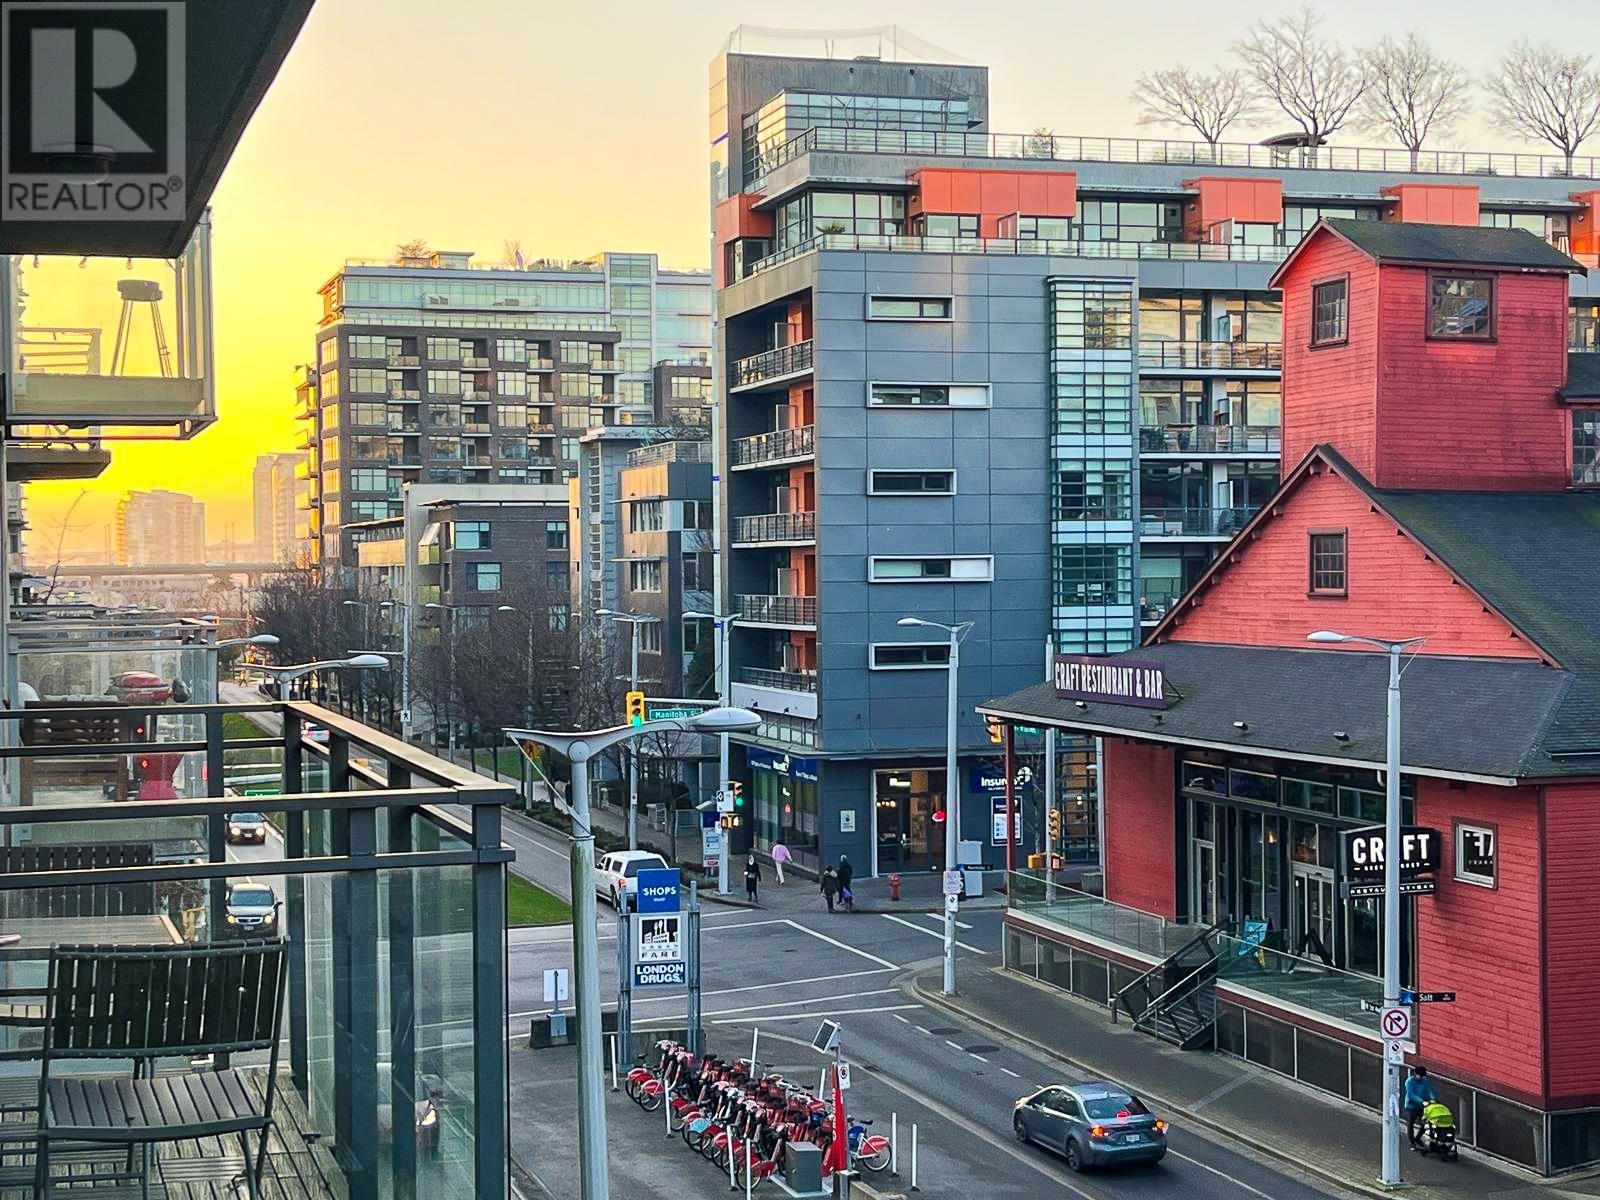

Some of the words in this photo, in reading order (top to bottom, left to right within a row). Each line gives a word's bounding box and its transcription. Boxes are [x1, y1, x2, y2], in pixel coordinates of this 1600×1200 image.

[1055, 662, 1080, 691] CRAFT
[1081, 664, 1134, 697] RESTAURANT
[1135, 668, 1143, 698] &
[1144, 669, 1163, 700] BAR
[1353, 834, 1430, 864] CRFT
[643, 886, 677, 897] SHOPS
[641, 950, 679, 959] FARE
[636, 963, 684, 975] LONDON
[640, 974, 682, 984] DRUGS
[1419, 994, 1434, 1002] Salt
